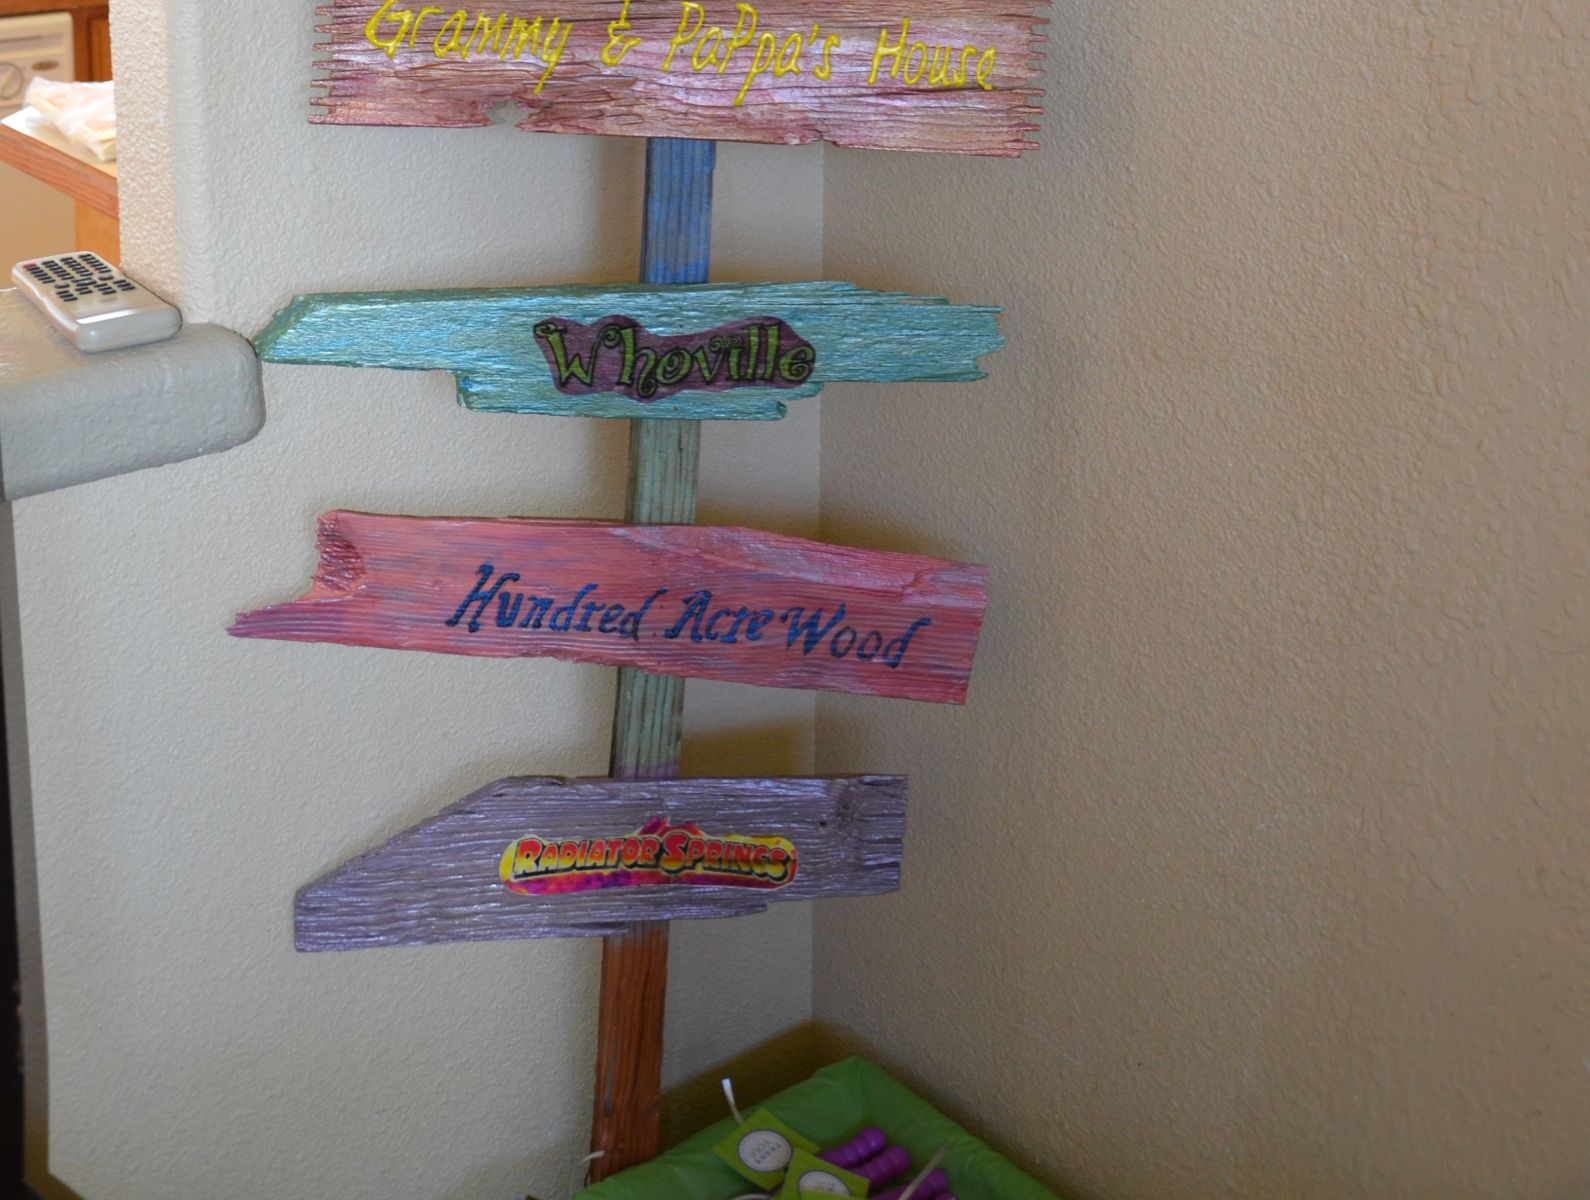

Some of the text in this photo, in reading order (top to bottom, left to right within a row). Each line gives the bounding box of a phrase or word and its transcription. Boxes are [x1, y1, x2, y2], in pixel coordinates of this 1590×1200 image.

[867, 16, 997, 91] House
[533, 321, 817, 398] Whoville
[445, 563, 668, 642] Hundred
[664, 589, 776, 645] Acre
